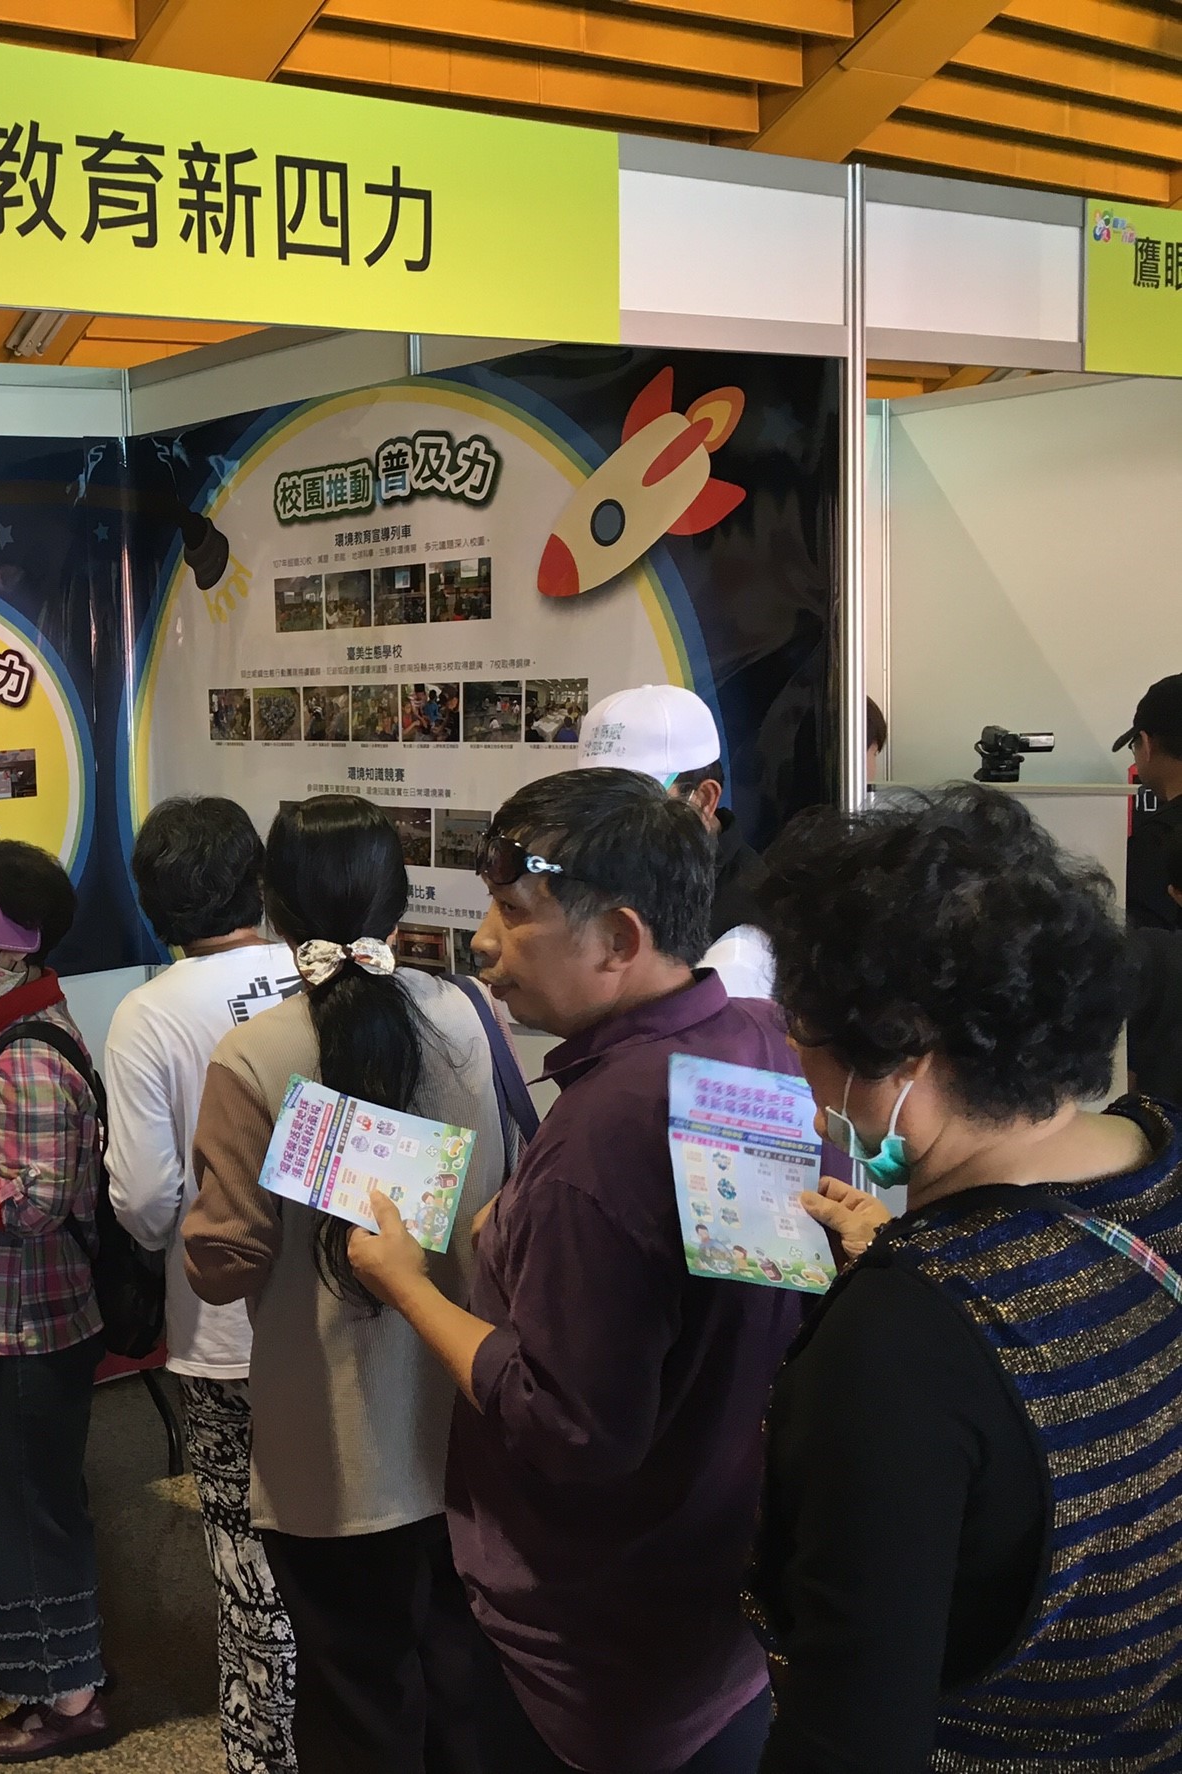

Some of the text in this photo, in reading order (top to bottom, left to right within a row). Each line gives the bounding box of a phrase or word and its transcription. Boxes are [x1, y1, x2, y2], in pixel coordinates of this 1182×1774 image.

[279, 442, 492, 515] 校園推動 普及力
[334, 524, 412, 548] 環境教育宣導列車
[346, 644, 403, 661] 臺美生態學校
[347, 766, 405, 783] 環境知識競賽
